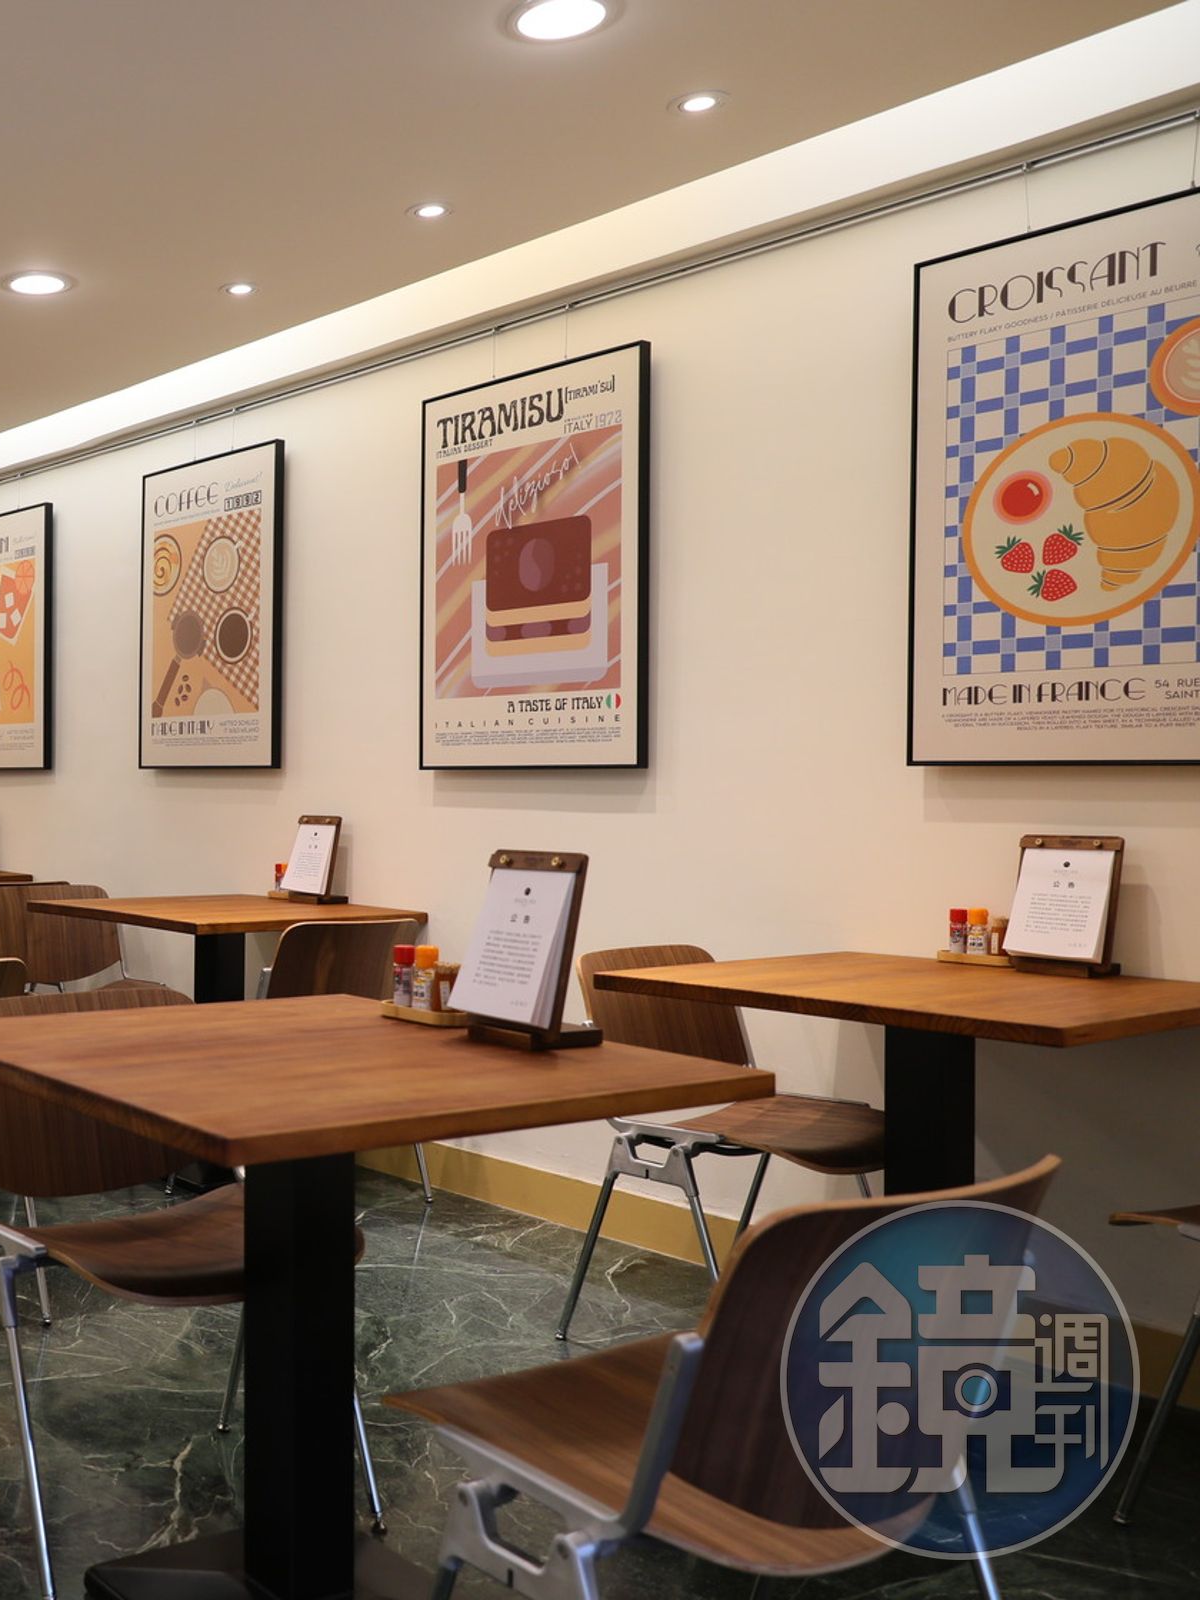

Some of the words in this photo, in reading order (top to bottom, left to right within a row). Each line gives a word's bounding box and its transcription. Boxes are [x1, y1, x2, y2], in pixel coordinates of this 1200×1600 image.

[948, 241, 1166, 323] CROISSANT
[436, 388, 565, 449] TIRAMISU
[564, 418, 593, 434] ITALY
[154, 482, 218, 518] COFFEE
[1036, 677, 1146, 703] FRANCE
[1177, 677, 1200, 688] RUE
[507, 701, 516, 713] A
[518, 698, 551, 713] TASTE
[555, 698, 568, 711] OF
[571, 695, 604, 710] ITALY
